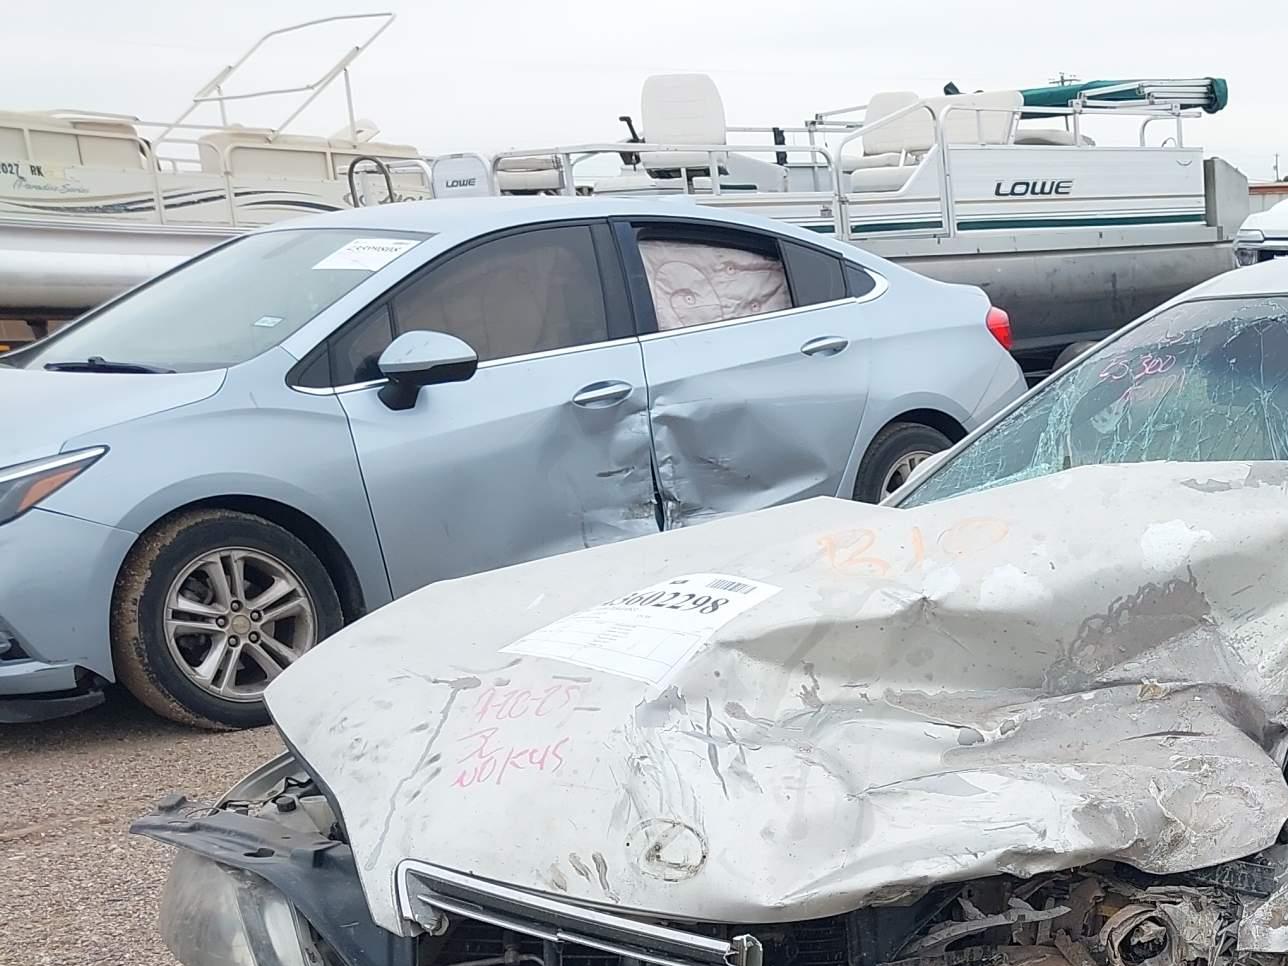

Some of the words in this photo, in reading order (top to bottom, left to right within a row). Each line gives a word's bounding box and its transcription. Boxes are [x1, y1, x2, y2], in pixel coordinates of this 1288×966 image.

[0, 163, 20, 177] 027
[446, 178, 476, 188] LOWE
[994, 180, 1073, 197] LOWE
